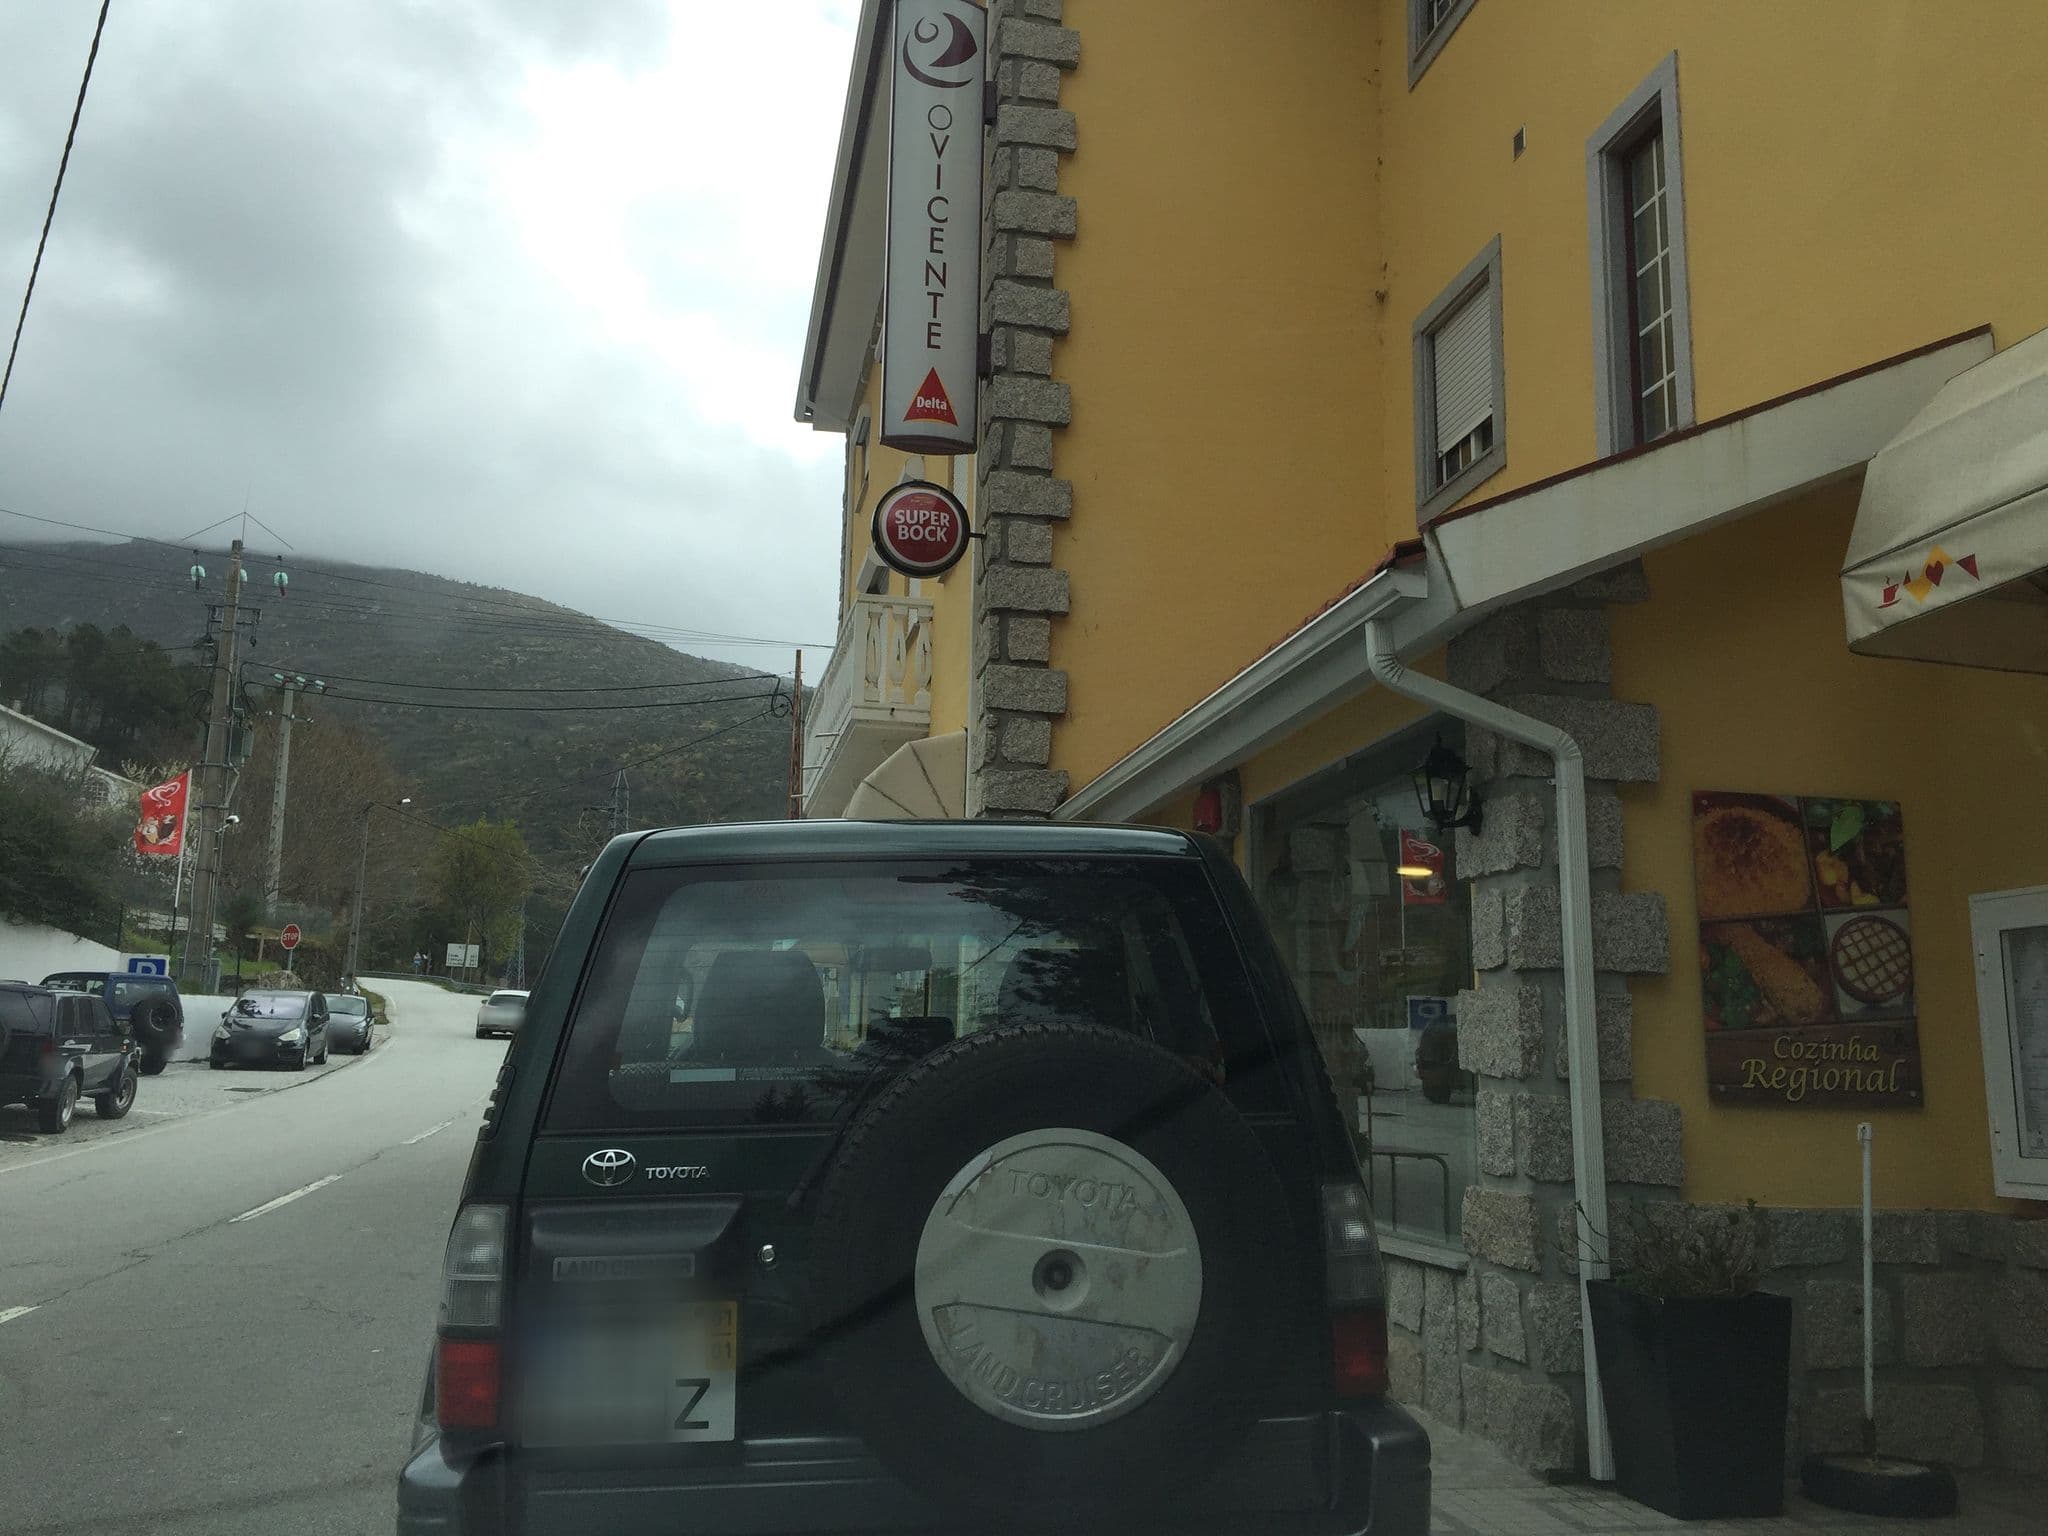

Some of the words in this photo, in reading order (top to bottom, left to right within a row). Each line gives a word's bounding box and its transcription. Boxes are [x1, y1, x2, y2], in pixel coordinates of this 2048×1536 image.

[916, 396, 947, 410] Delta
[895, 509, 950, 527] SUPER
[898, 525, 948, 542] BOCK
[283, 932, 298, 941] STOP
[136, 962, 157, 976] P
[1773, 1034, 1880, 1063] Cozinha
[1741, 1056, 1906, 1102] Regional
[645, 1166, 711, 1180] TOYOTA
[1008, 1168, 1141, 1211] TOYOTA
[946, 1315, 1019, 1398] LAND
[1023, 1344, 1153, 1410] CRUISER
